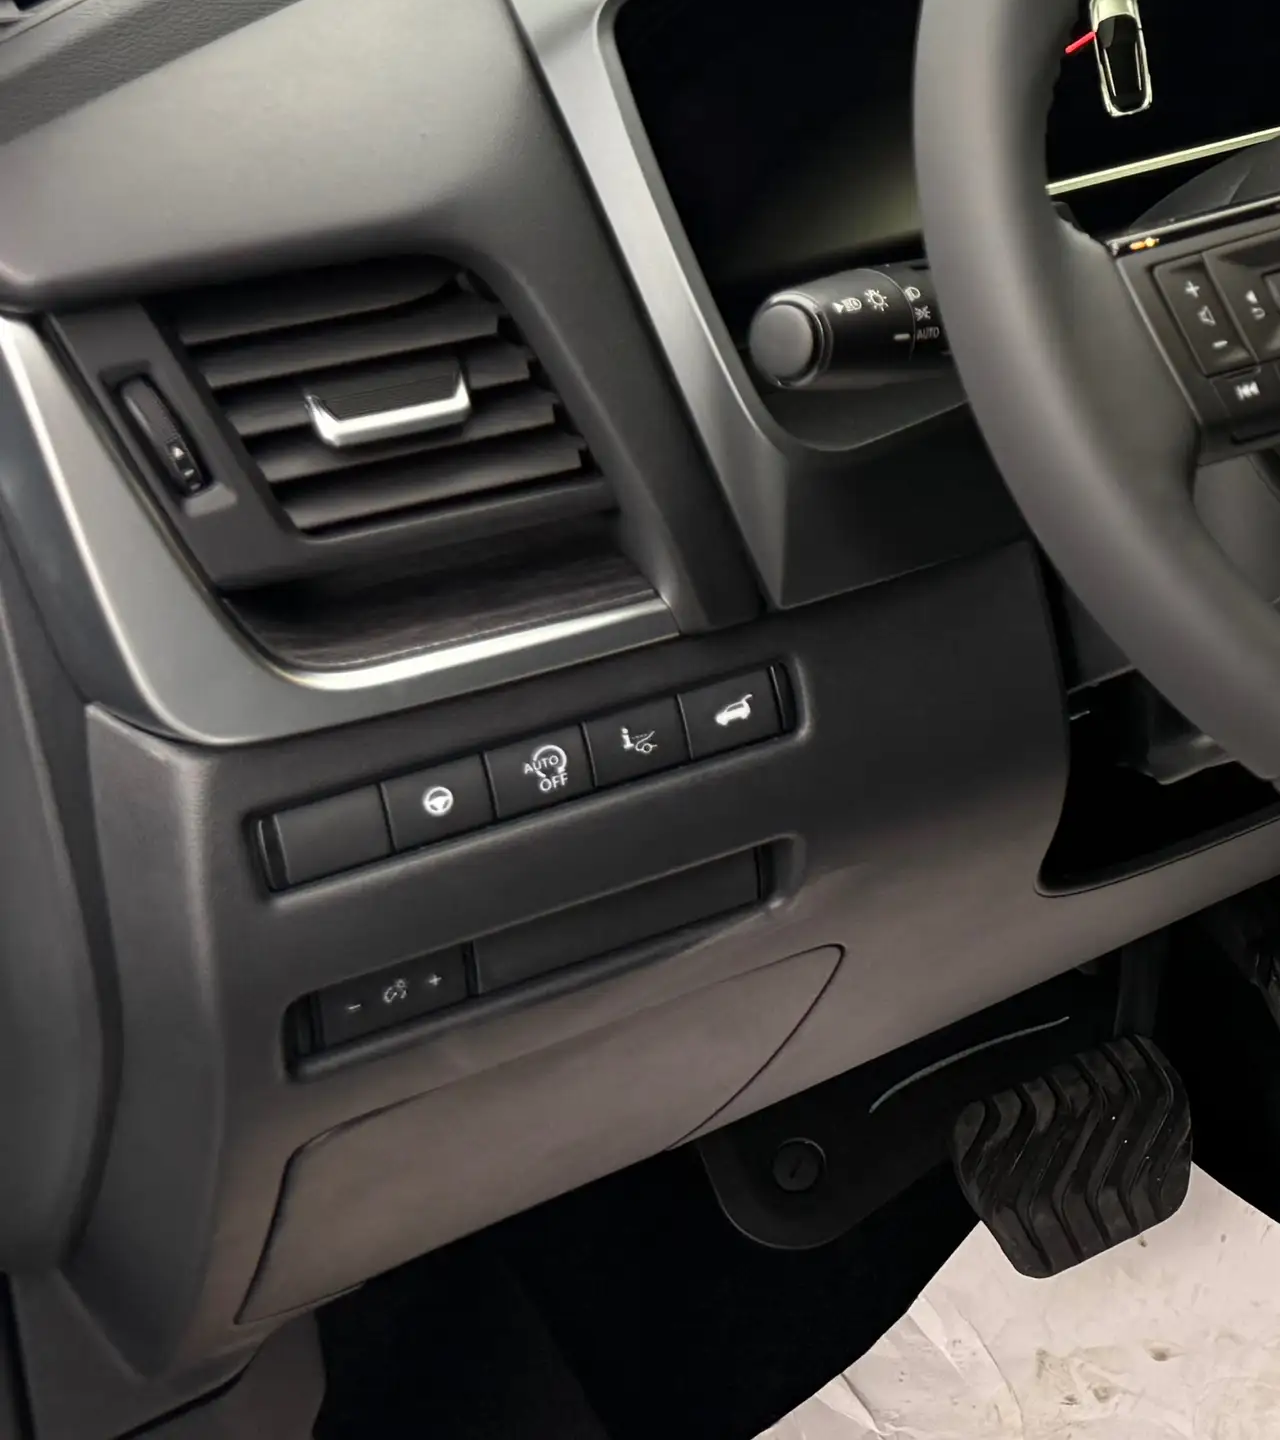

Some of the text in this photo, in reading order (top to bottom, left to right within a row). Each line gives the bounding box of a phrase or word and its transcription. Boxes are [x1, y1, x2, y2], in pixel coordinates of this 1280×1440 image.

[916, 326, 940, 340] AUTO
[523, 754, 560, 775] AUTO
[539, 772, 568, 792] OFF
